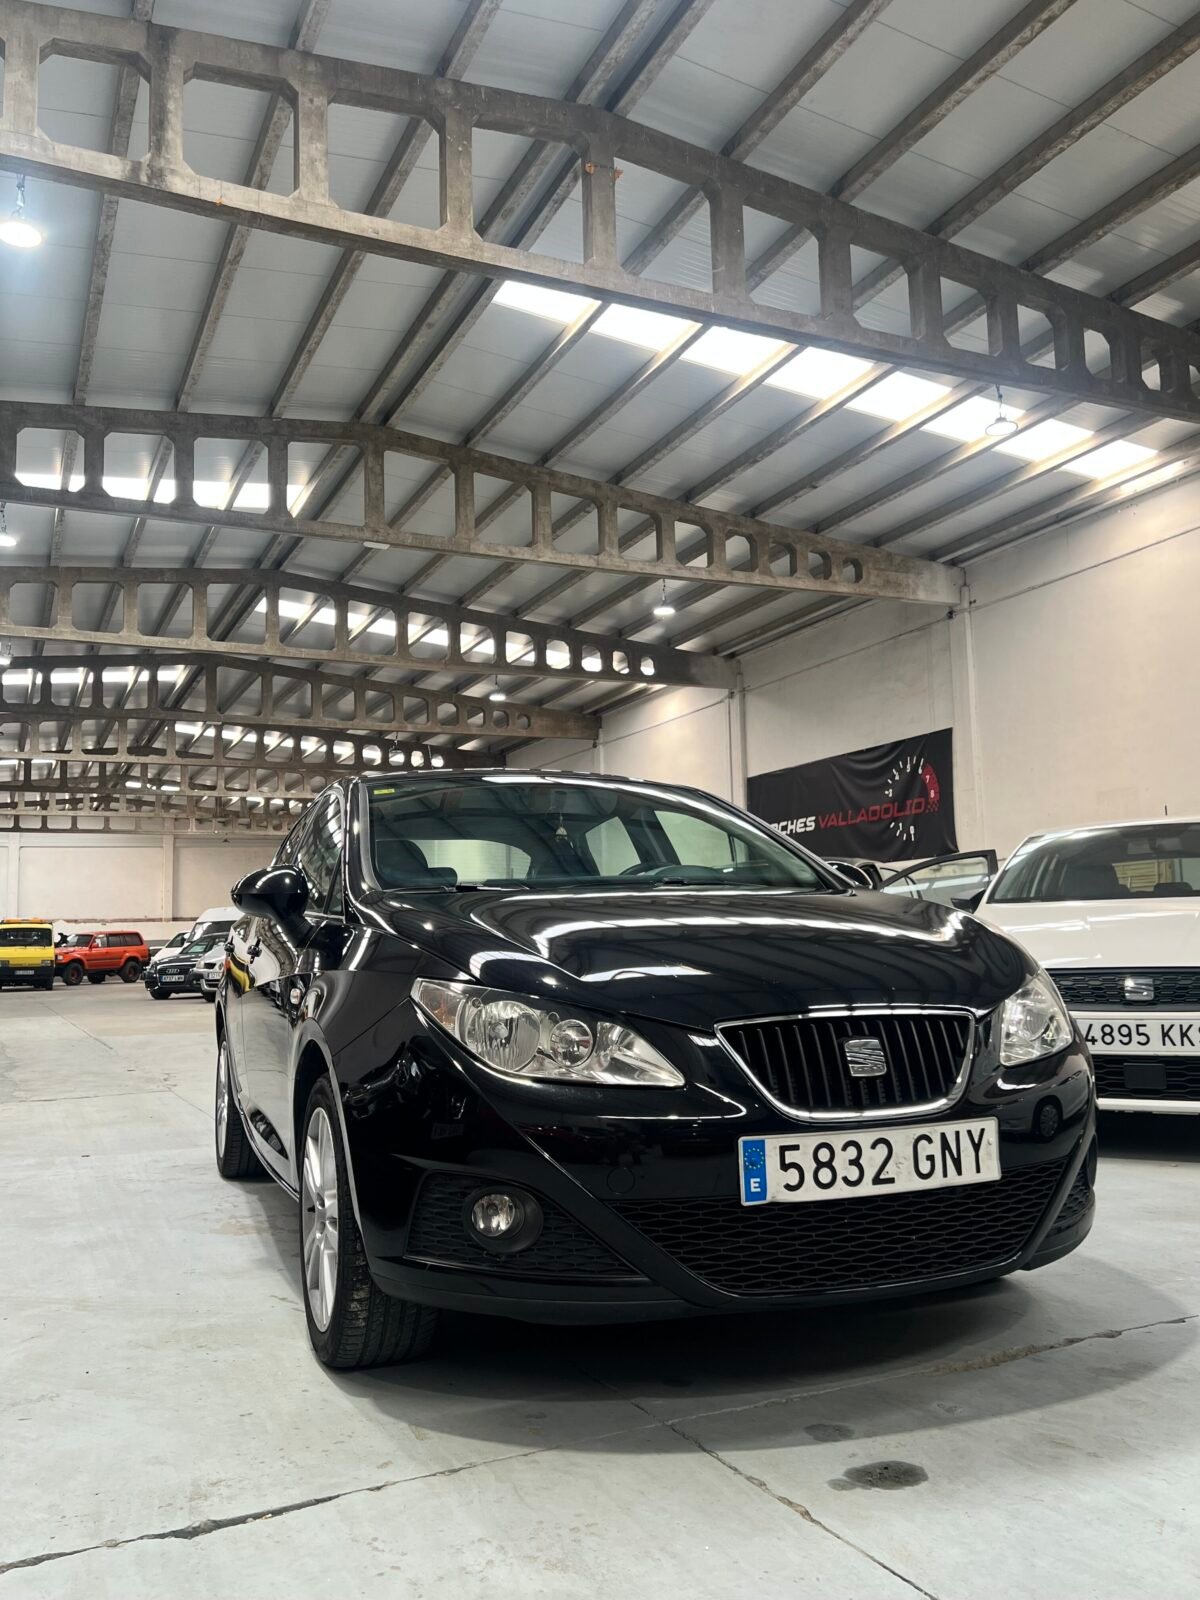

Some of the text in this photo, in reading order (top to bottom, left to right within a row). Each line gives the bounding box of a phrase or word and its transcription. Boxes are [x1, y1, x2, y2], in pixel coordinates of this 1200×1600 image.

[925, 774, 930, 783] 7
[818, 798, 925, 829] VALLADOLID
[1085, 1023, 1200, 1047] 4895 KK
[750, 1127, 985, 1192] E 5832 GNY
